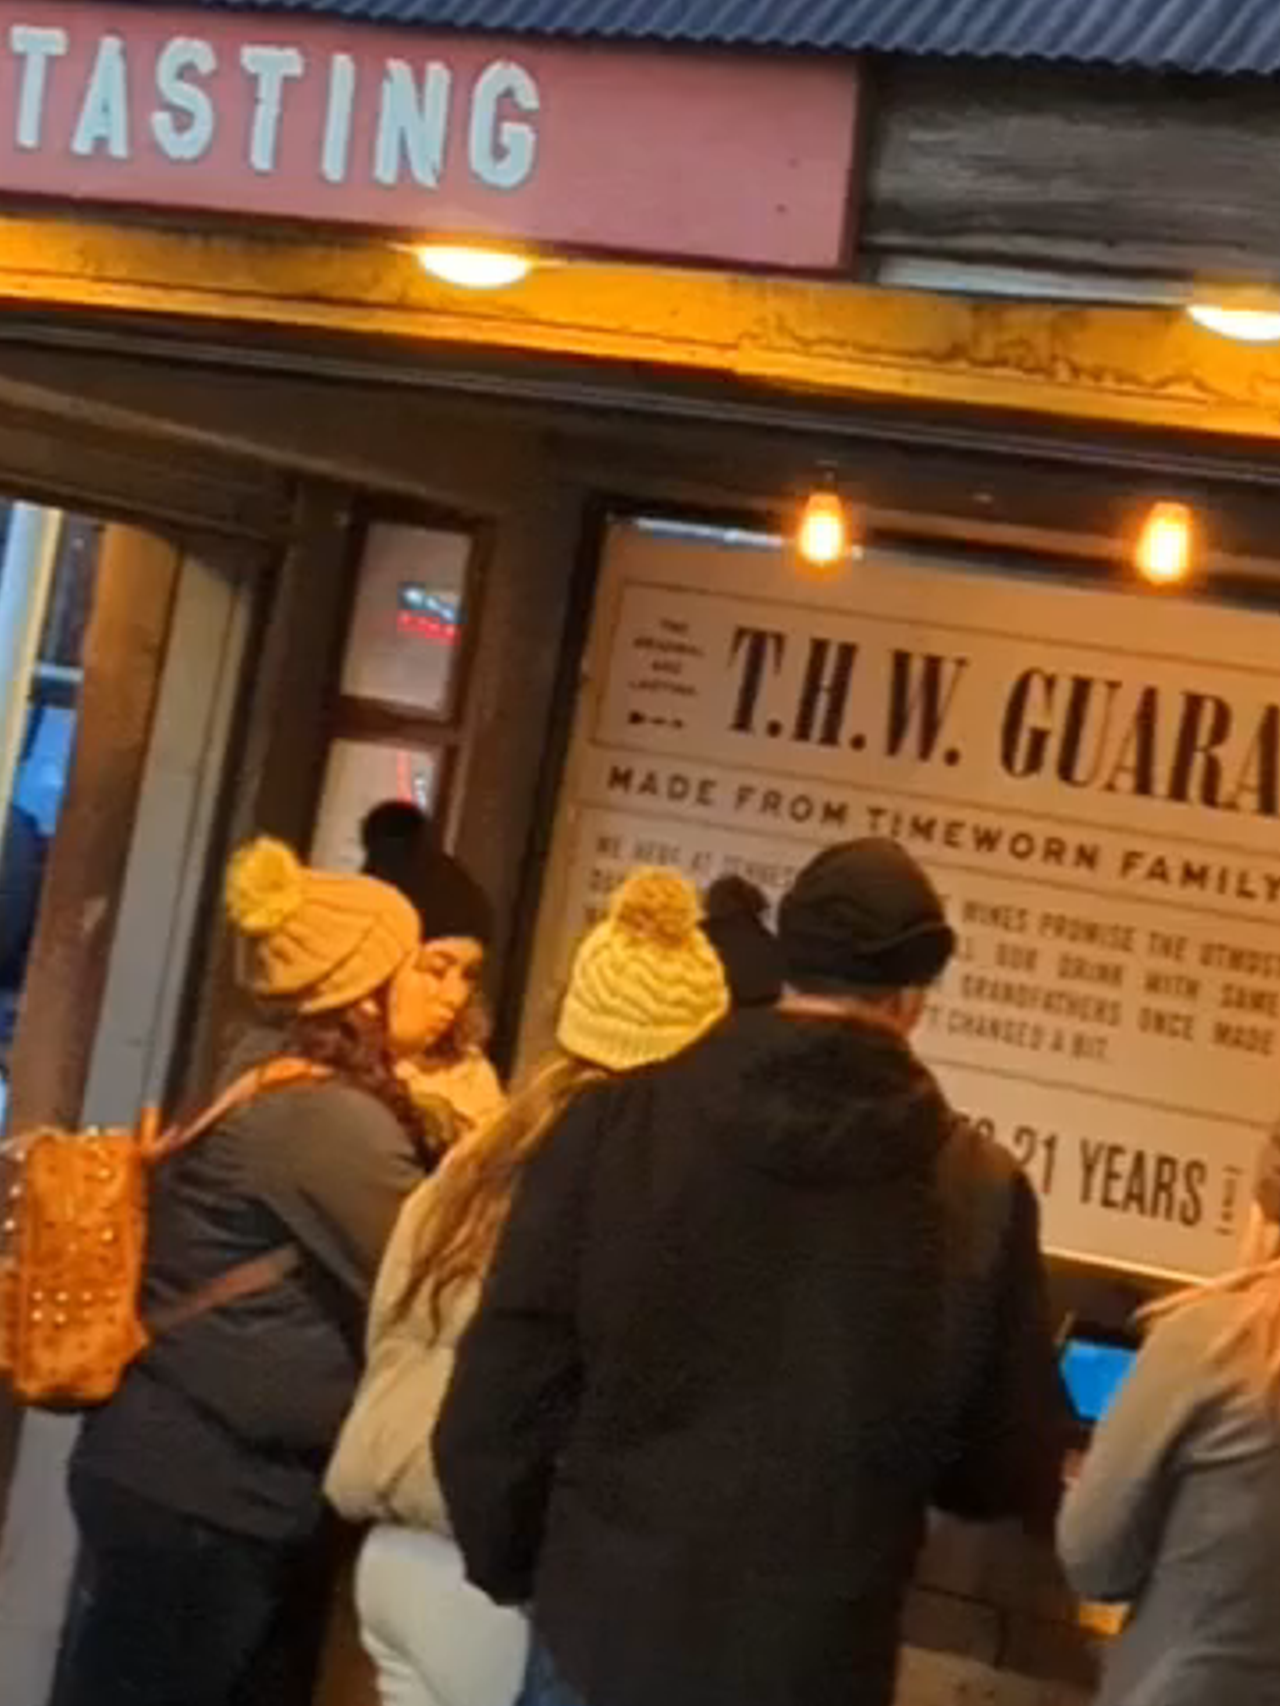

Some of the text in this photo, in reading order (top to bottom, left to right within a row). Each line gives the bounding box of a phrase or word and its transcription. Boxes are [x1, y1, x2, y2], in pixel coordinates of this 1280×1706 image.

[7, 24, 541, 188] TASTING
[726, 625, 970, 767] T.H.W.
[607, 765, 718, 806] MADE
[734, 786, 849, 828] FROM
[866, 805, 1103, 872] TIMEWORN
[1038, 911, 1137, 953] PROMISE
[1147, 930, 1190, 963] THE
[947, 1009, 1044, 1052] CHANGED
[1048, 1031, 1065, 1053] A
[1136, 1005, 1197, 1042] ONCE
[1213, 1021, 1277, 1057] MADE
[1143, 970, 1201, 1002] WITH
[1219, 982, 1280, 1019] SAME
[1012, 1125, 1059, 1196] 21
[1078, 1136, 1208, 1228] YEARS
